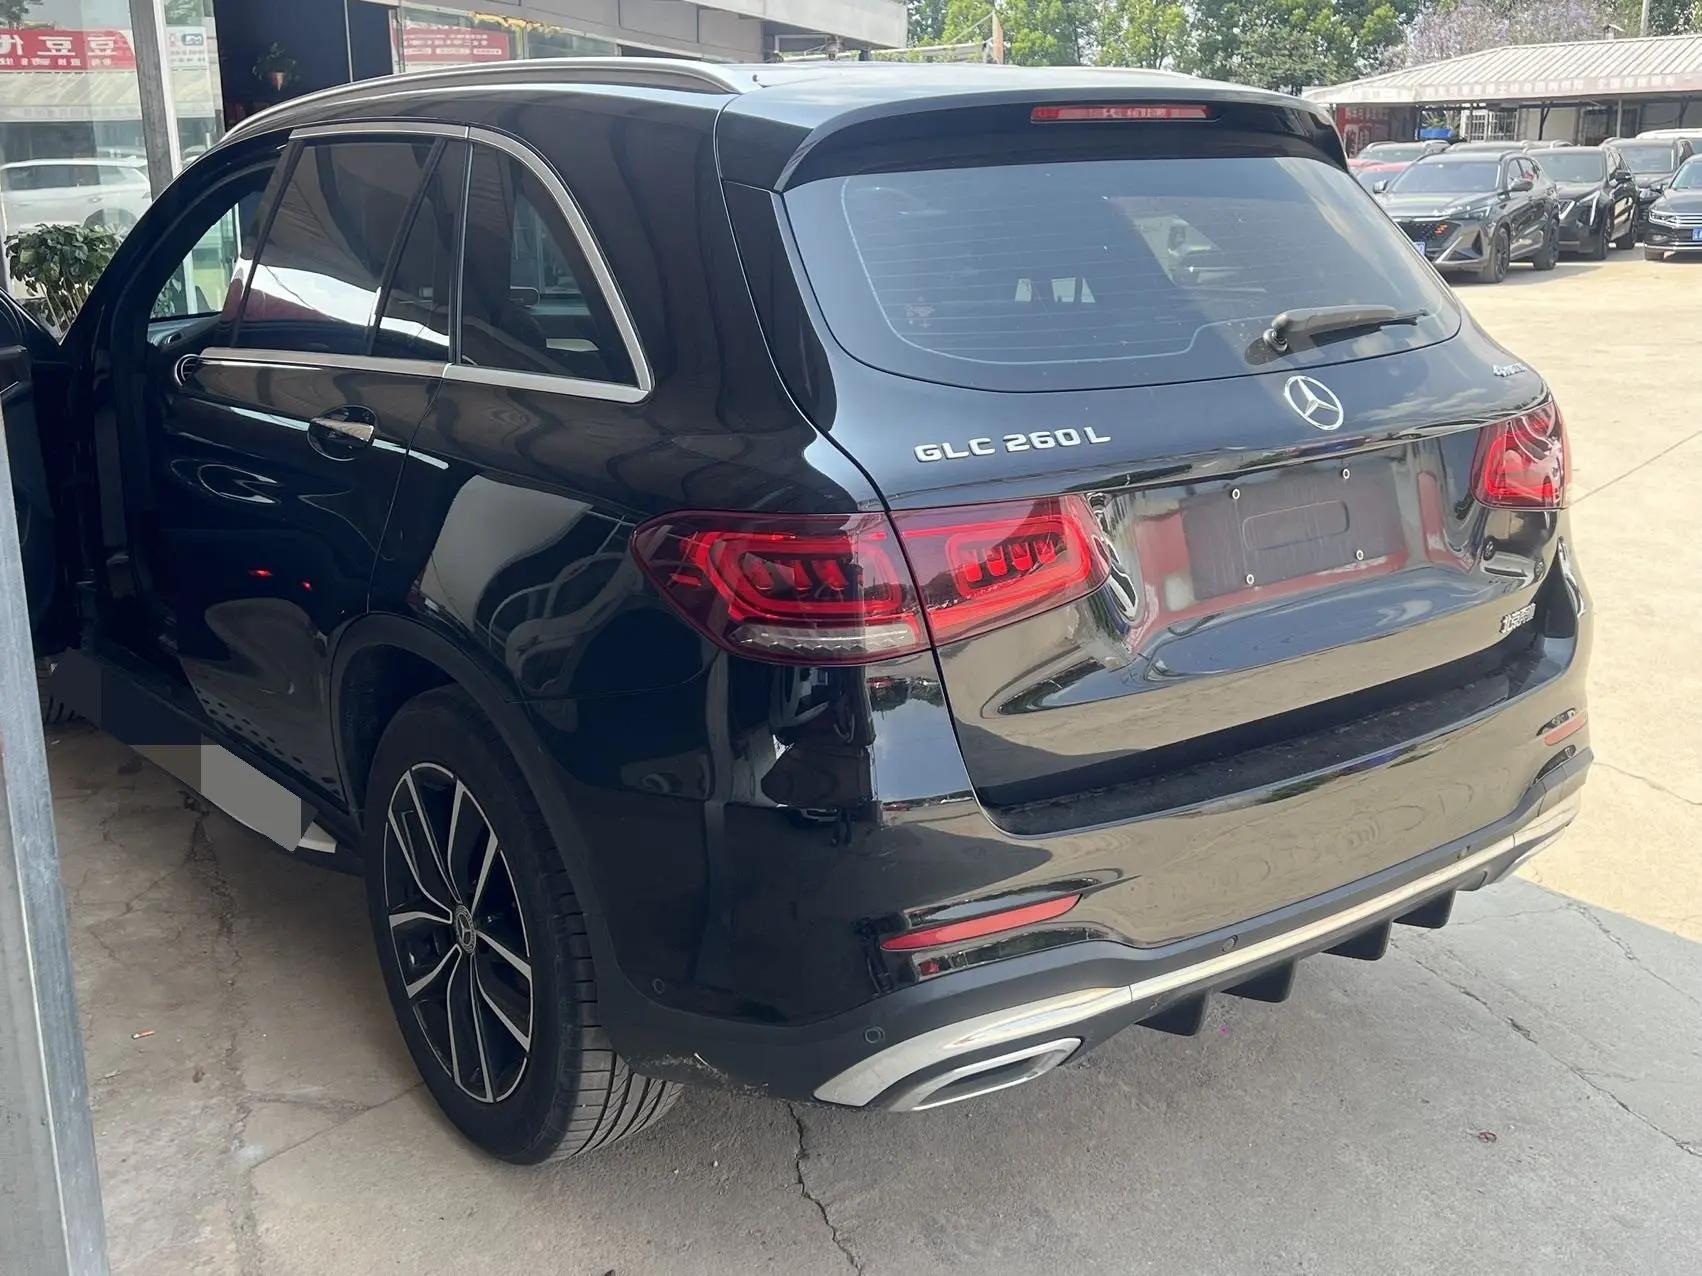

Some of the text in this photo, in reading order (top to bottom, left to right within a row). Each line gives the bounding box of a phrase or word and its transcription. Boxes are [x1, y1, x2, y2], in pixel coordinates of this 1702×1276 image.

[914, 427, 1111, 462] GLC 260 L
